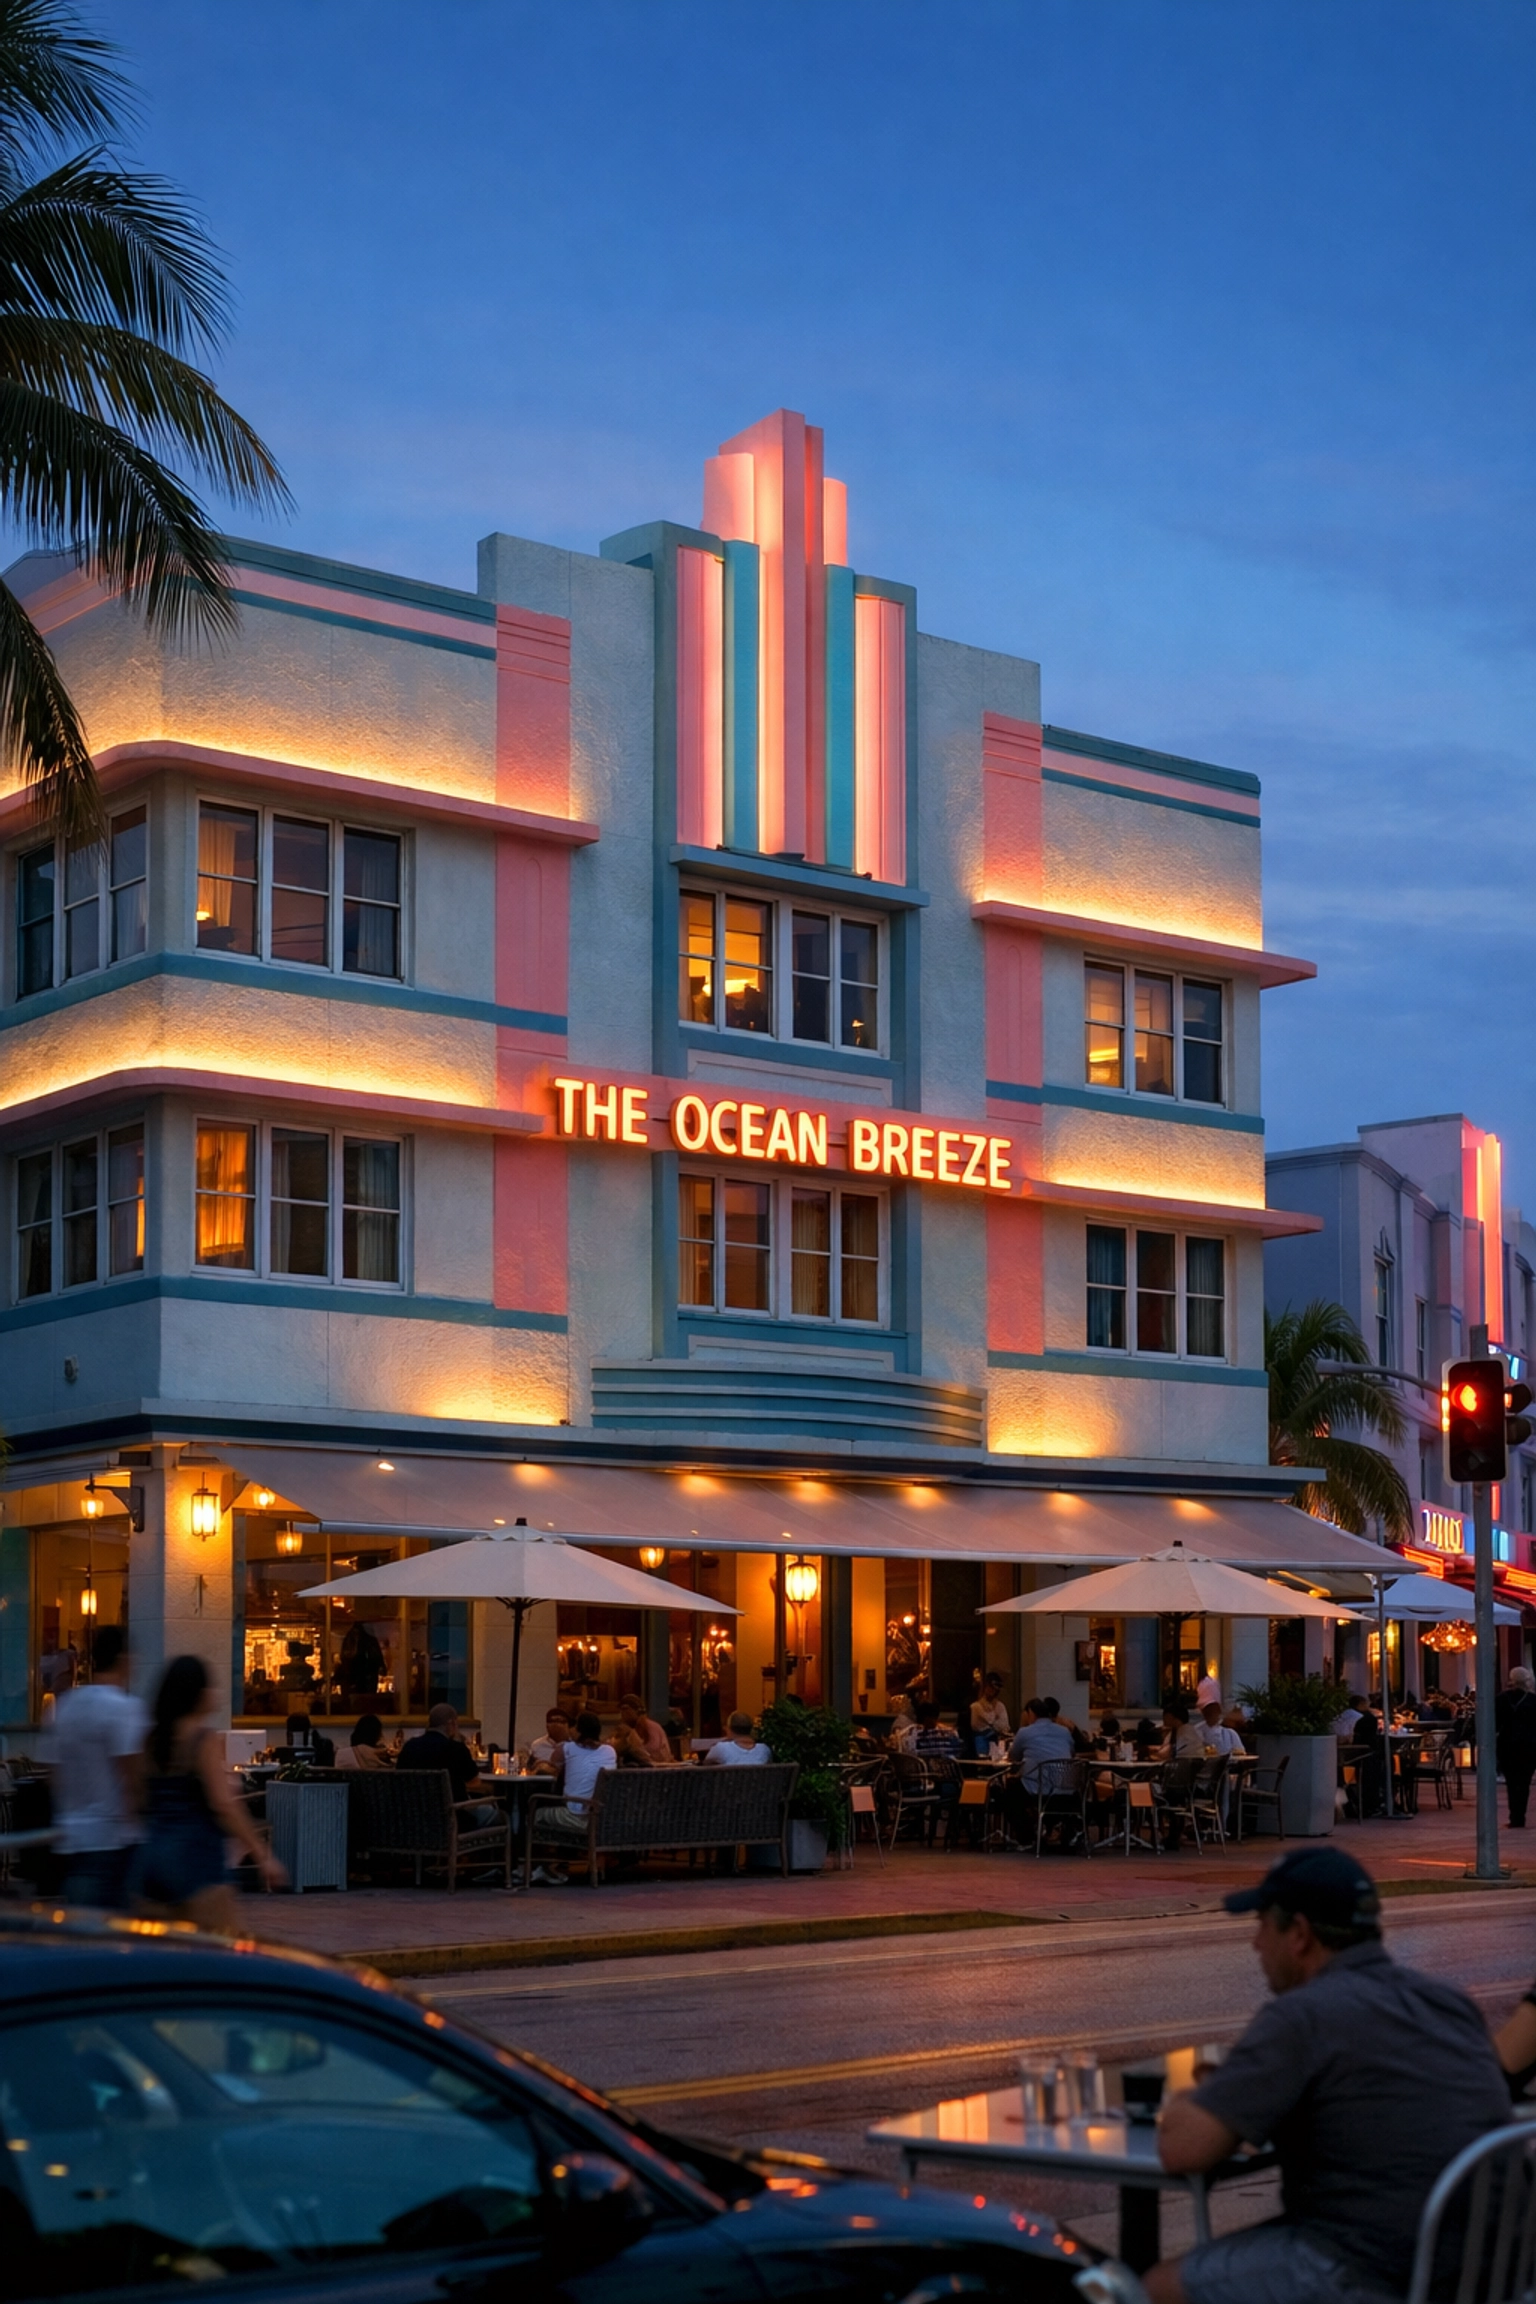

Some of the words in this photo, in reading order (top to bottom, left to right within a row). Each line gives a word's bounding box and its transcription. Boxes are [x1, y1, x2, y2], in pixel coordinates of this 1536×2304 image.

[553, 1077, 649, 1145] THE
[673, 1095, 828, 1166] OCEAN
[851, 1118, 1013, 1190] BREEZE
